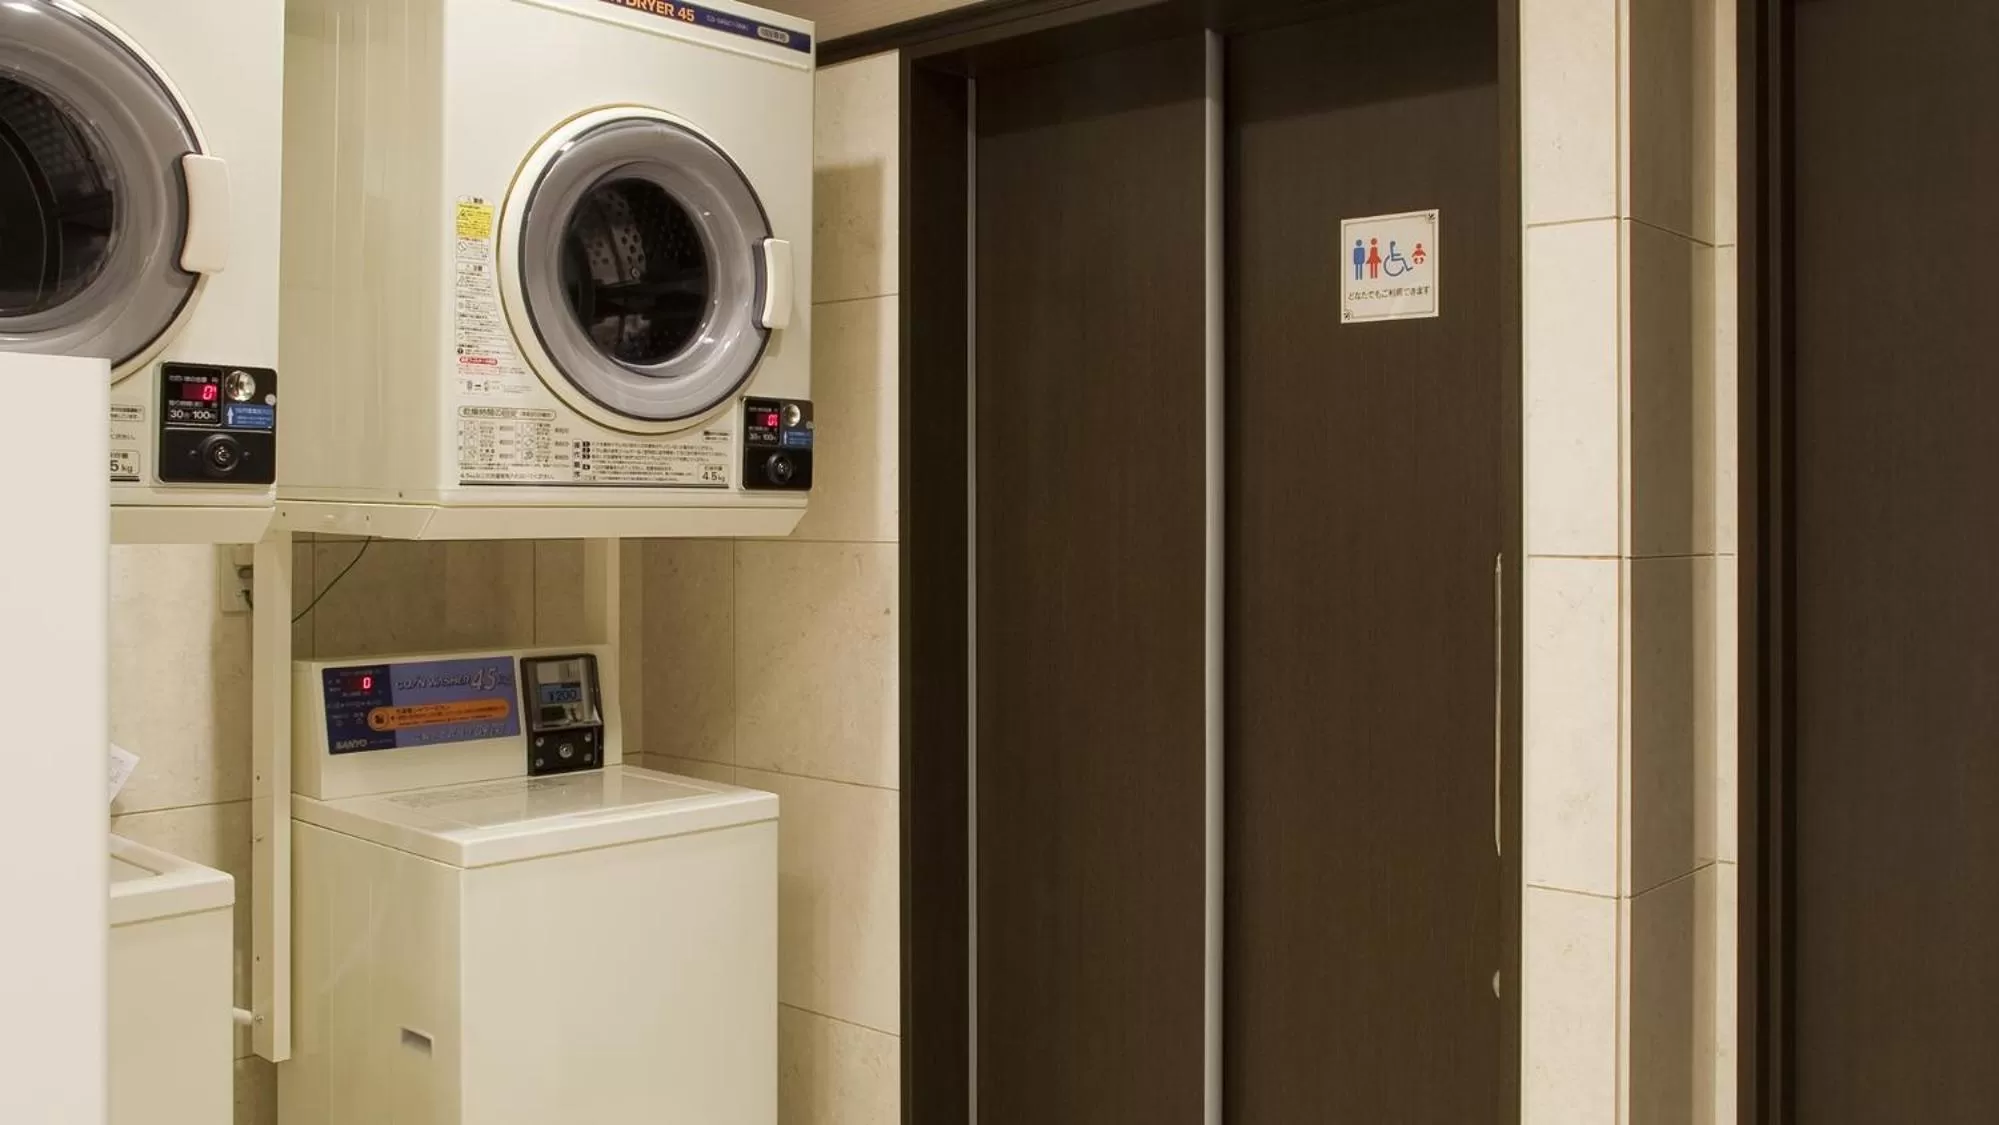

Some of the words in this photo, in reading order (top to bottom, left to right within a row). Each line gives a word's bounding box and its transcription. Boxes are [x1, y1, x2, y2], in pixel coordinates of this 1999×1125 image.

[626, 0, 675, 17] DRYER
[677, 7, 695, 22] 45
[363, 677, 372, 689] 0
